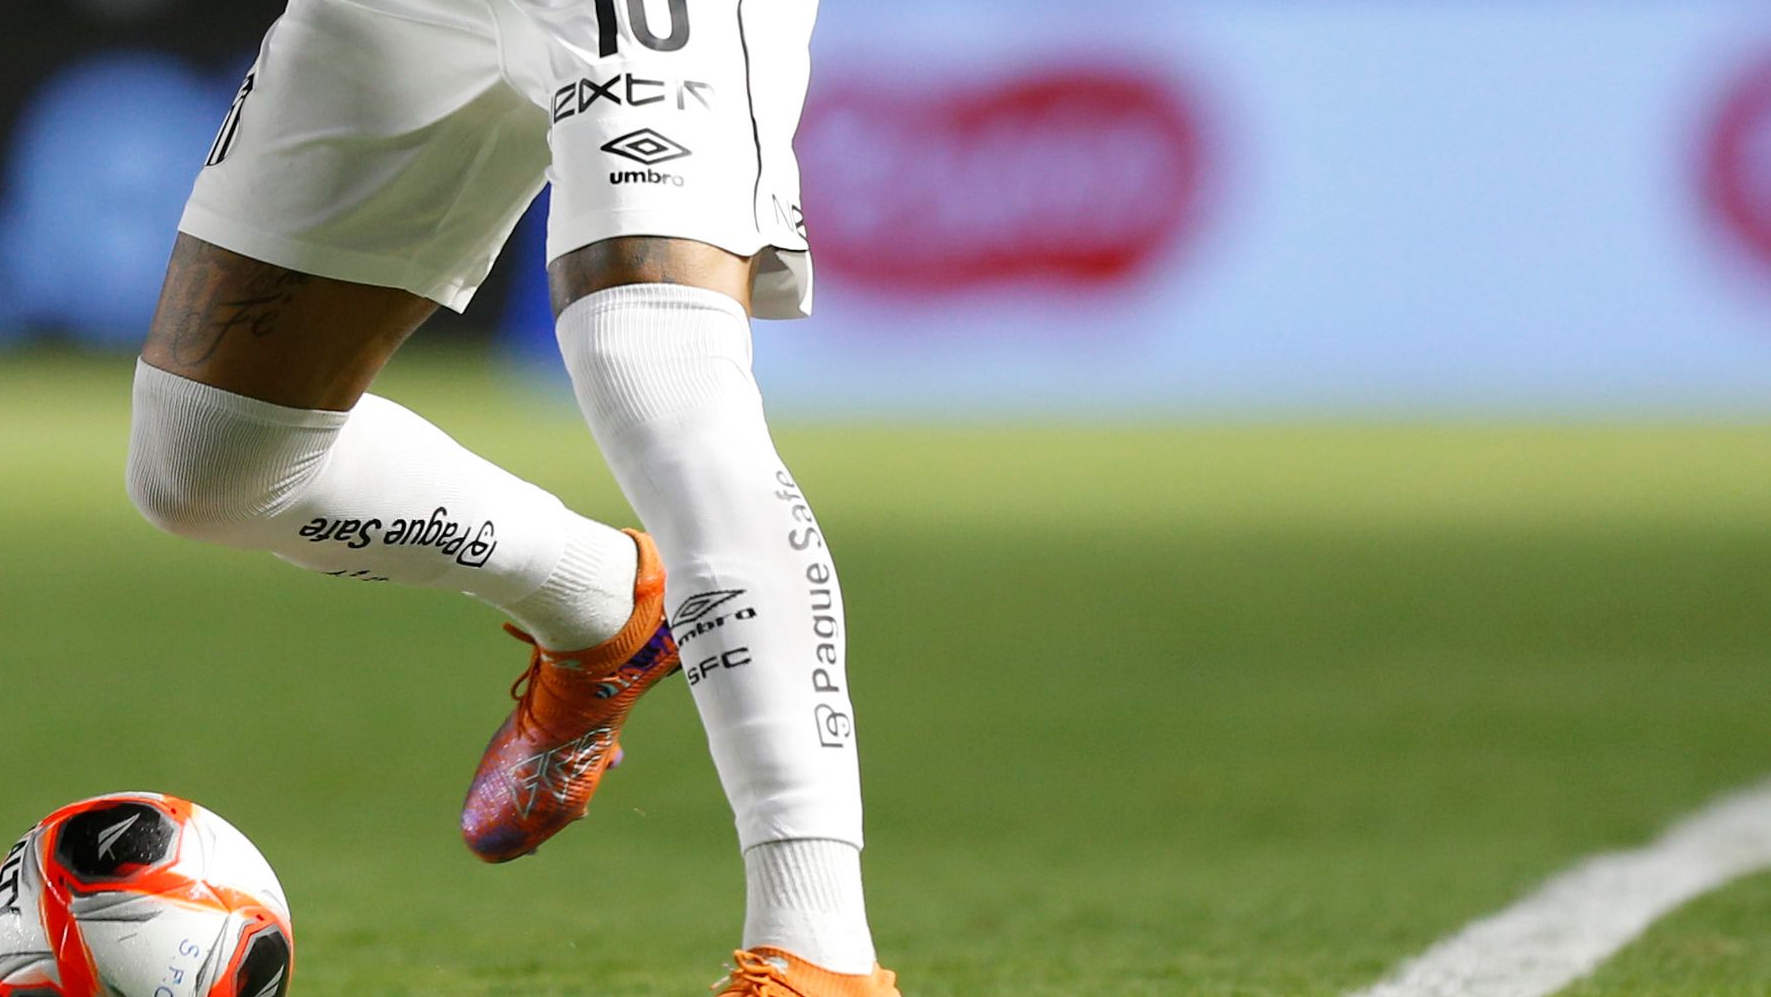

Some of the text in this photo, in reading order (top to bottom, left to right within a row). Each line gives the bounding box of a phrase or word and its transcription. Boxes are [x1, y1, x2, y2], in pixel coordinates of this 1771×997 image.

[609, 169, 684, 187] umbro
[299, 506, 472, 556] Pague Safe
[775, 470, 840, 694] Pague Safe
[688, 647, 751, 685] SFC
